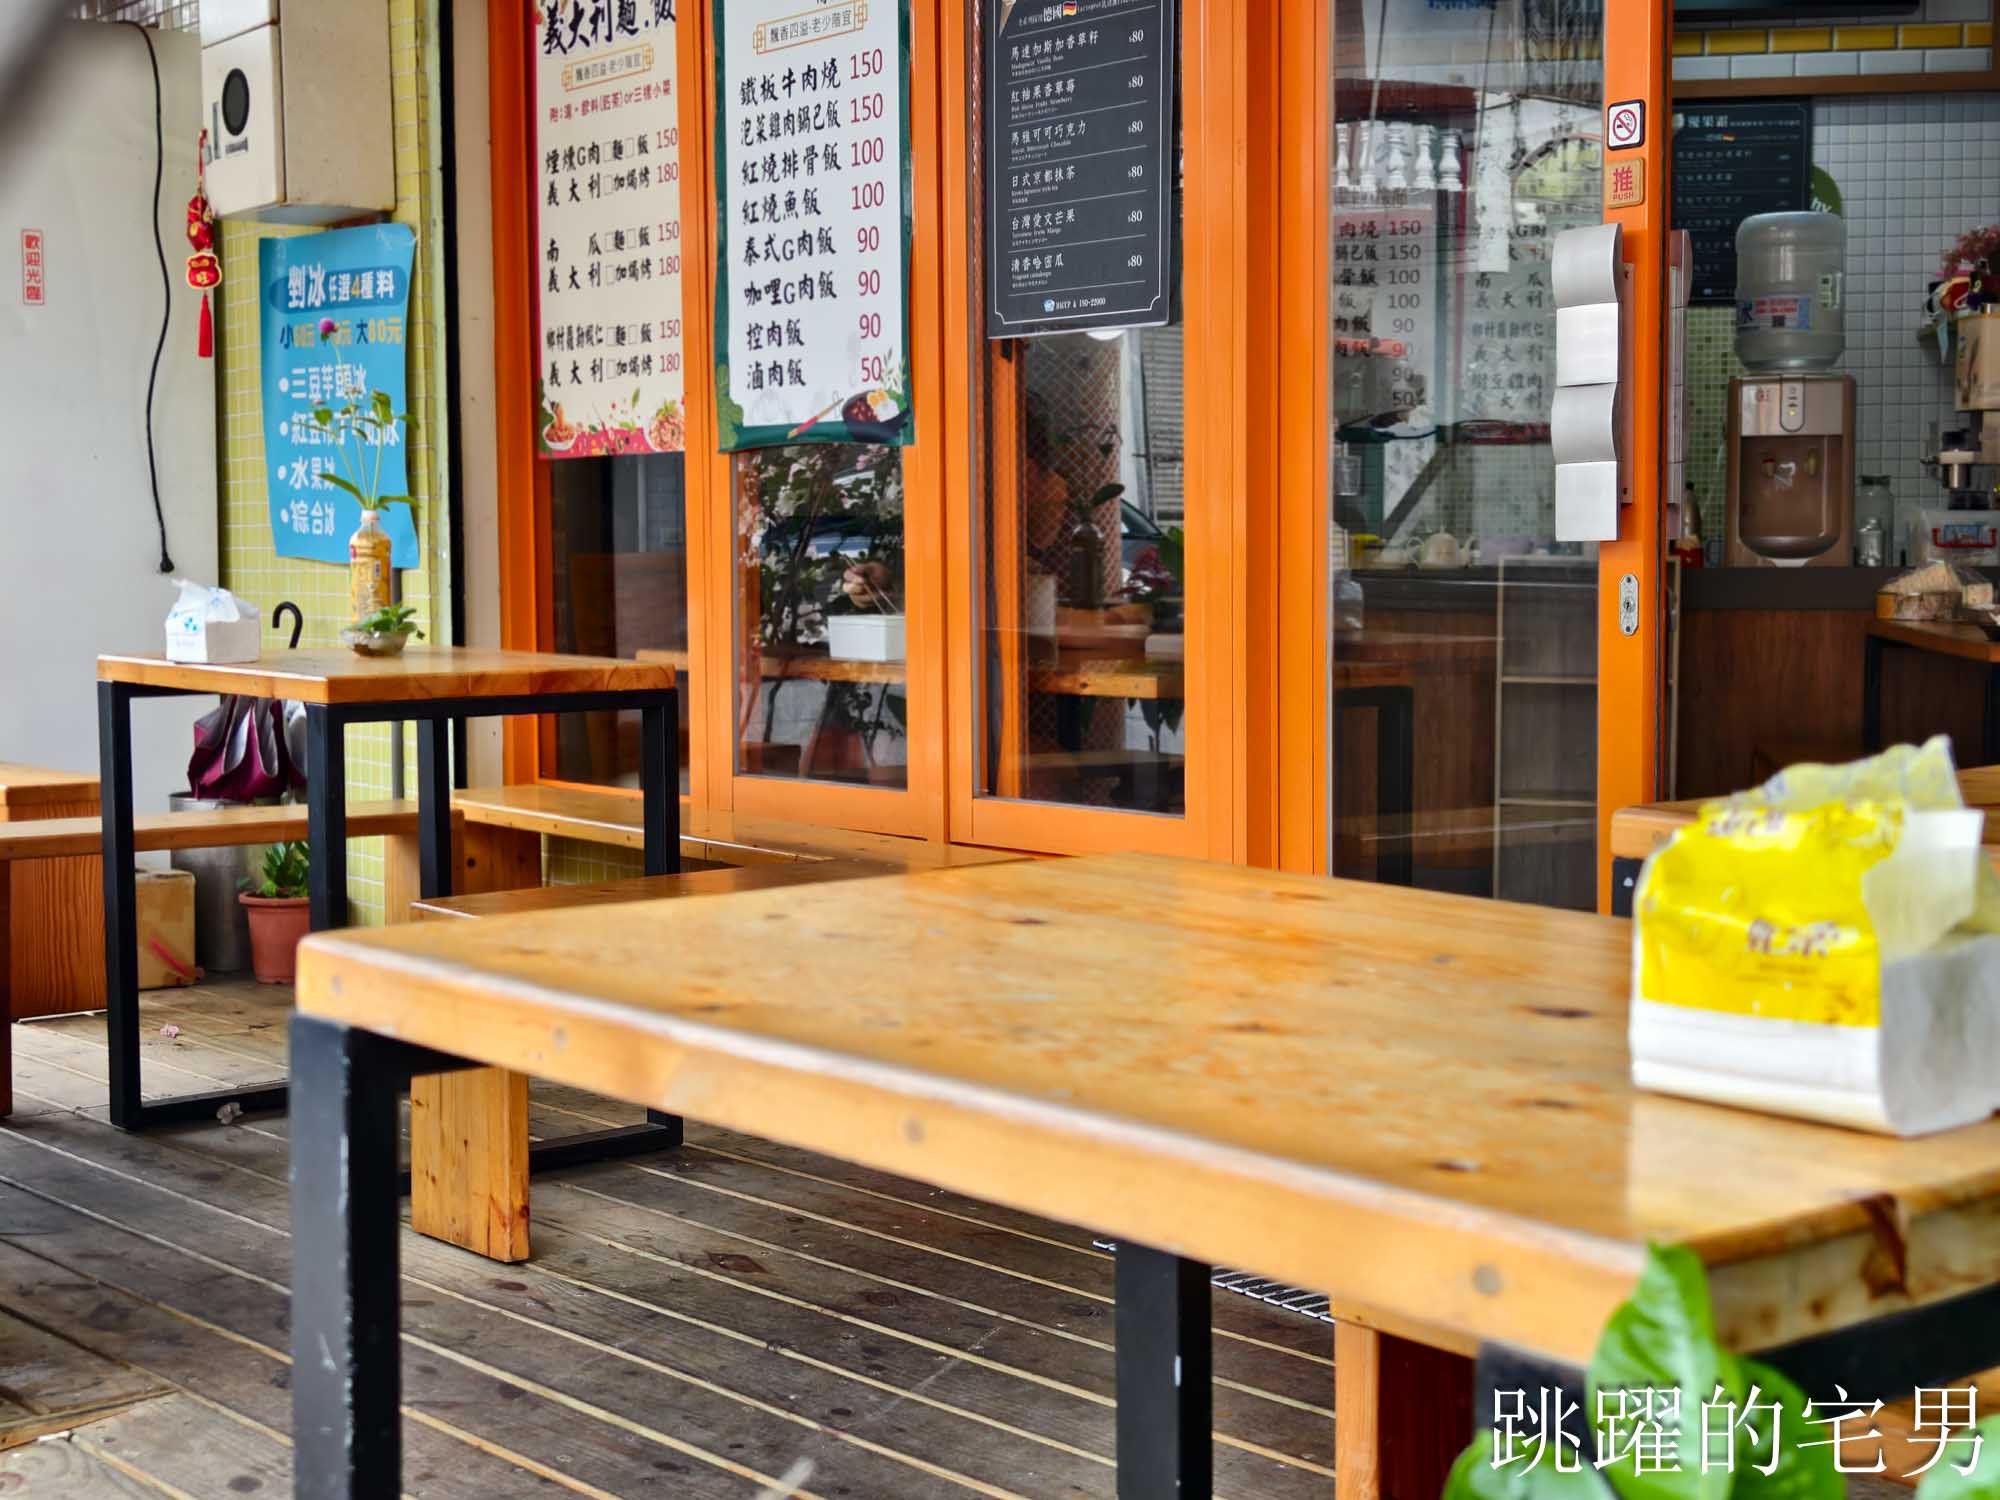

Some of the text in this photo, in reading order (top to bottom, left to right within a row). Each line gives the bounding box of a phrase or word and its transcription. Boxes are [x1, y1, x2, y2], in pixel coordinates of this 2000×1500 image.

[740, 48, 883, 107] 鐵板牛肉燒 150
[850, 92, 883, 124] 150
[656, 128, 678, 149] 150
[657, 162, 678, 184] 180
[742, 137, 884, 186] 紅燒排骨飯 100
[1613, 166, 1633, 192] 推
[742, 181, 885, 226] 紅燒魚飯 100
[658, 221, 679, 241] 150
[744, 226, 879, 266] 泰式G肉飯 90
[659, 256, 680, 276] 180
[744, 269, 880, 306] 咖哩G肉飯 90
[660, 319, 680, 339] 150
[746, 313, 881, 351] 控肉飯 90
[660, 353, 680, 373] 180
[747, 356, 882, 390] 滷肉飯 50
